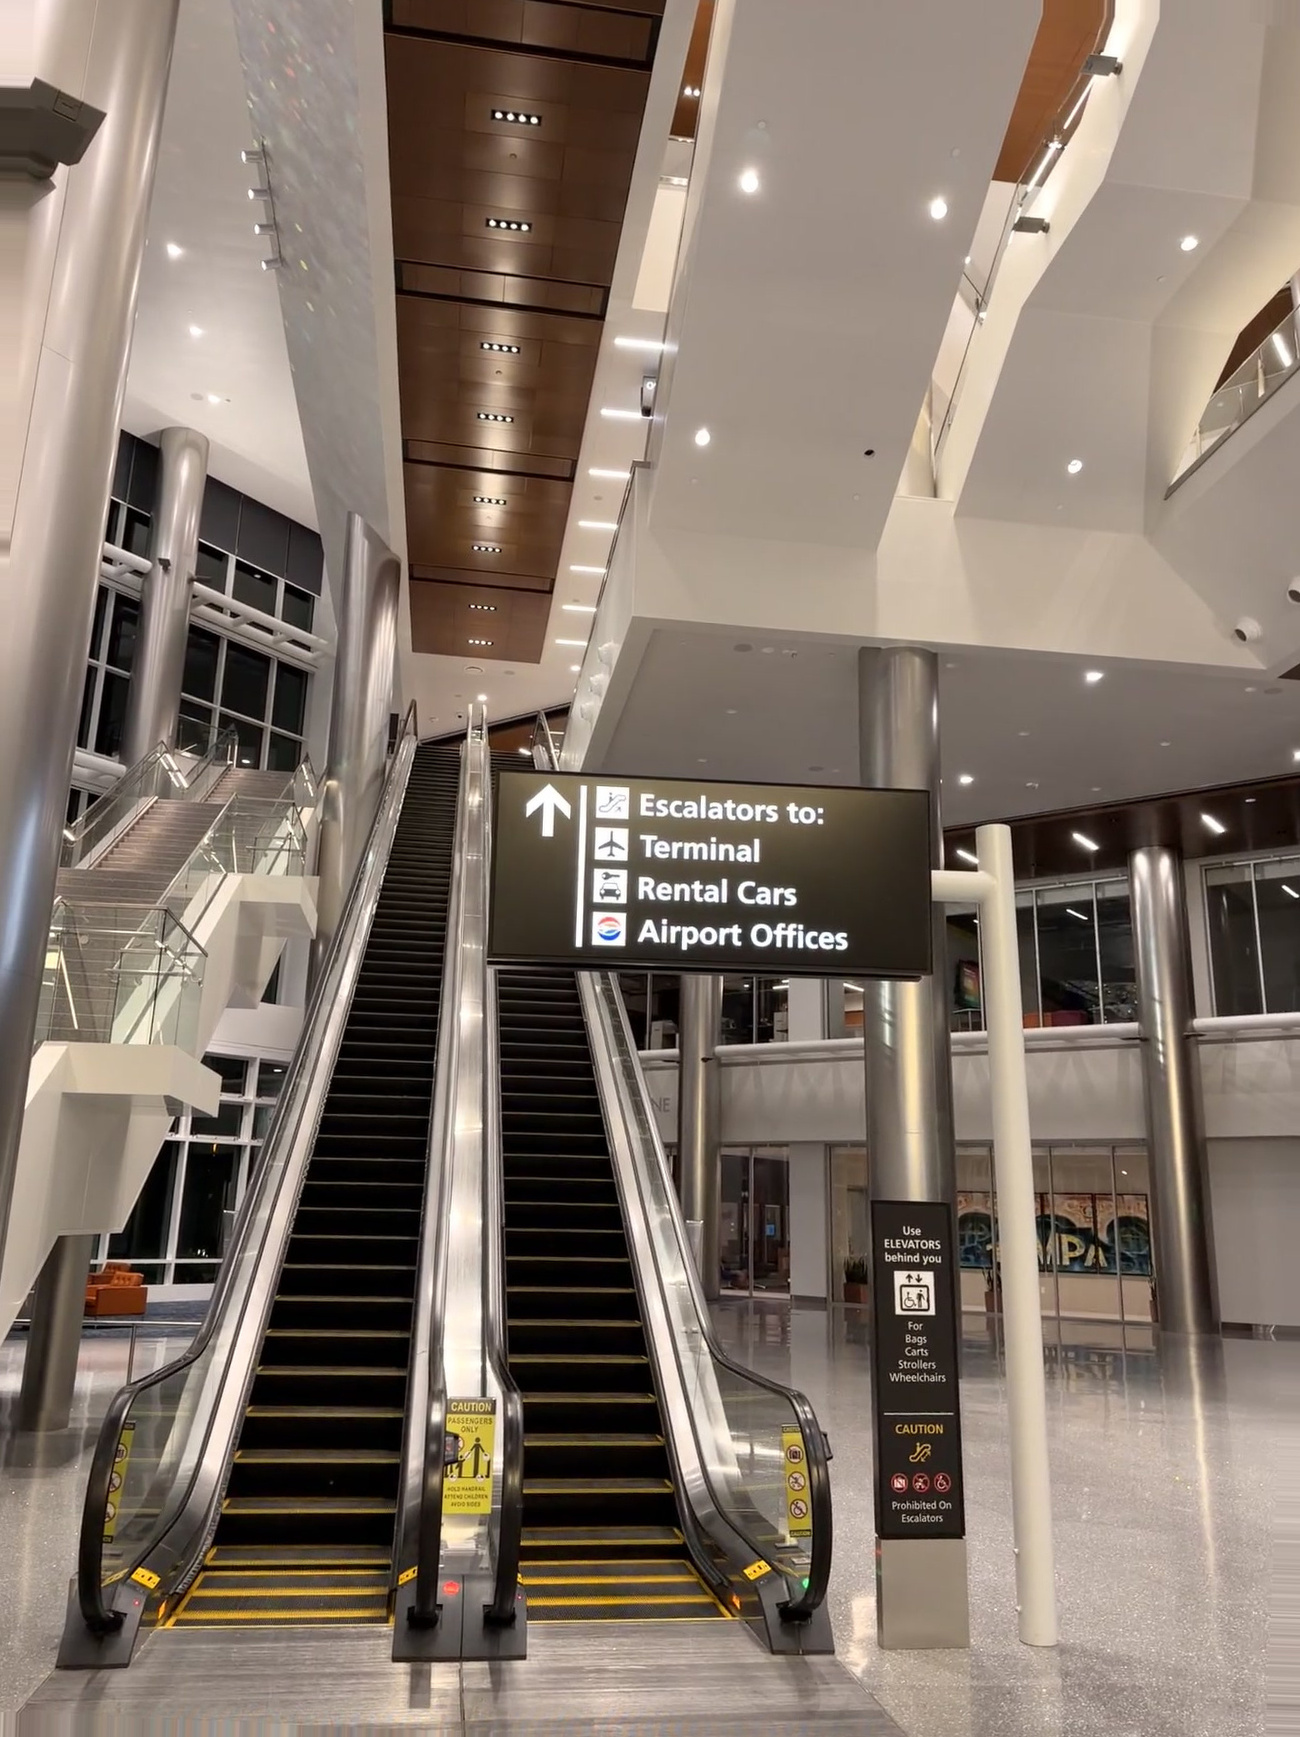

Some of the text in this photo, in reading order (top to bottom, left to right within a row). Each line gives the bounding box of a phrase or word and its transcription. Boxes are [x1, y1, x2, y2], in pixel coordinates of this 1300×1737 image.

[639, 794, 825, 825] Escalators to:
[639, 834, 760, 863] Terminal
[638, 877, 797, 906] Rental Cars
[638, 919, 849, 951] Airport Offices
[902, 1226, 922, 1236] Use
[884, 1239, 941, 1250] ELEVATORS
[885, 1252, 942, 1265] behind you
[908, 1321, 924, 1331] For
[905, 1334, 927, 1345] Bags
[905, 1347, 928, 1356] Carts
[898, 1360, 936, 1369] Strollers
[889, 1372, 946, 1383] Wheelchairs
[451, 1402, 492, 1412] CAUTION
[447, 1417, 493, 1425] PASSENGERS
[895, 1424, 944, 1434] CAUTION
[892, 1500, 952, 1510] Prohibited On
[901, 1513, 943, 1523] Escalators
